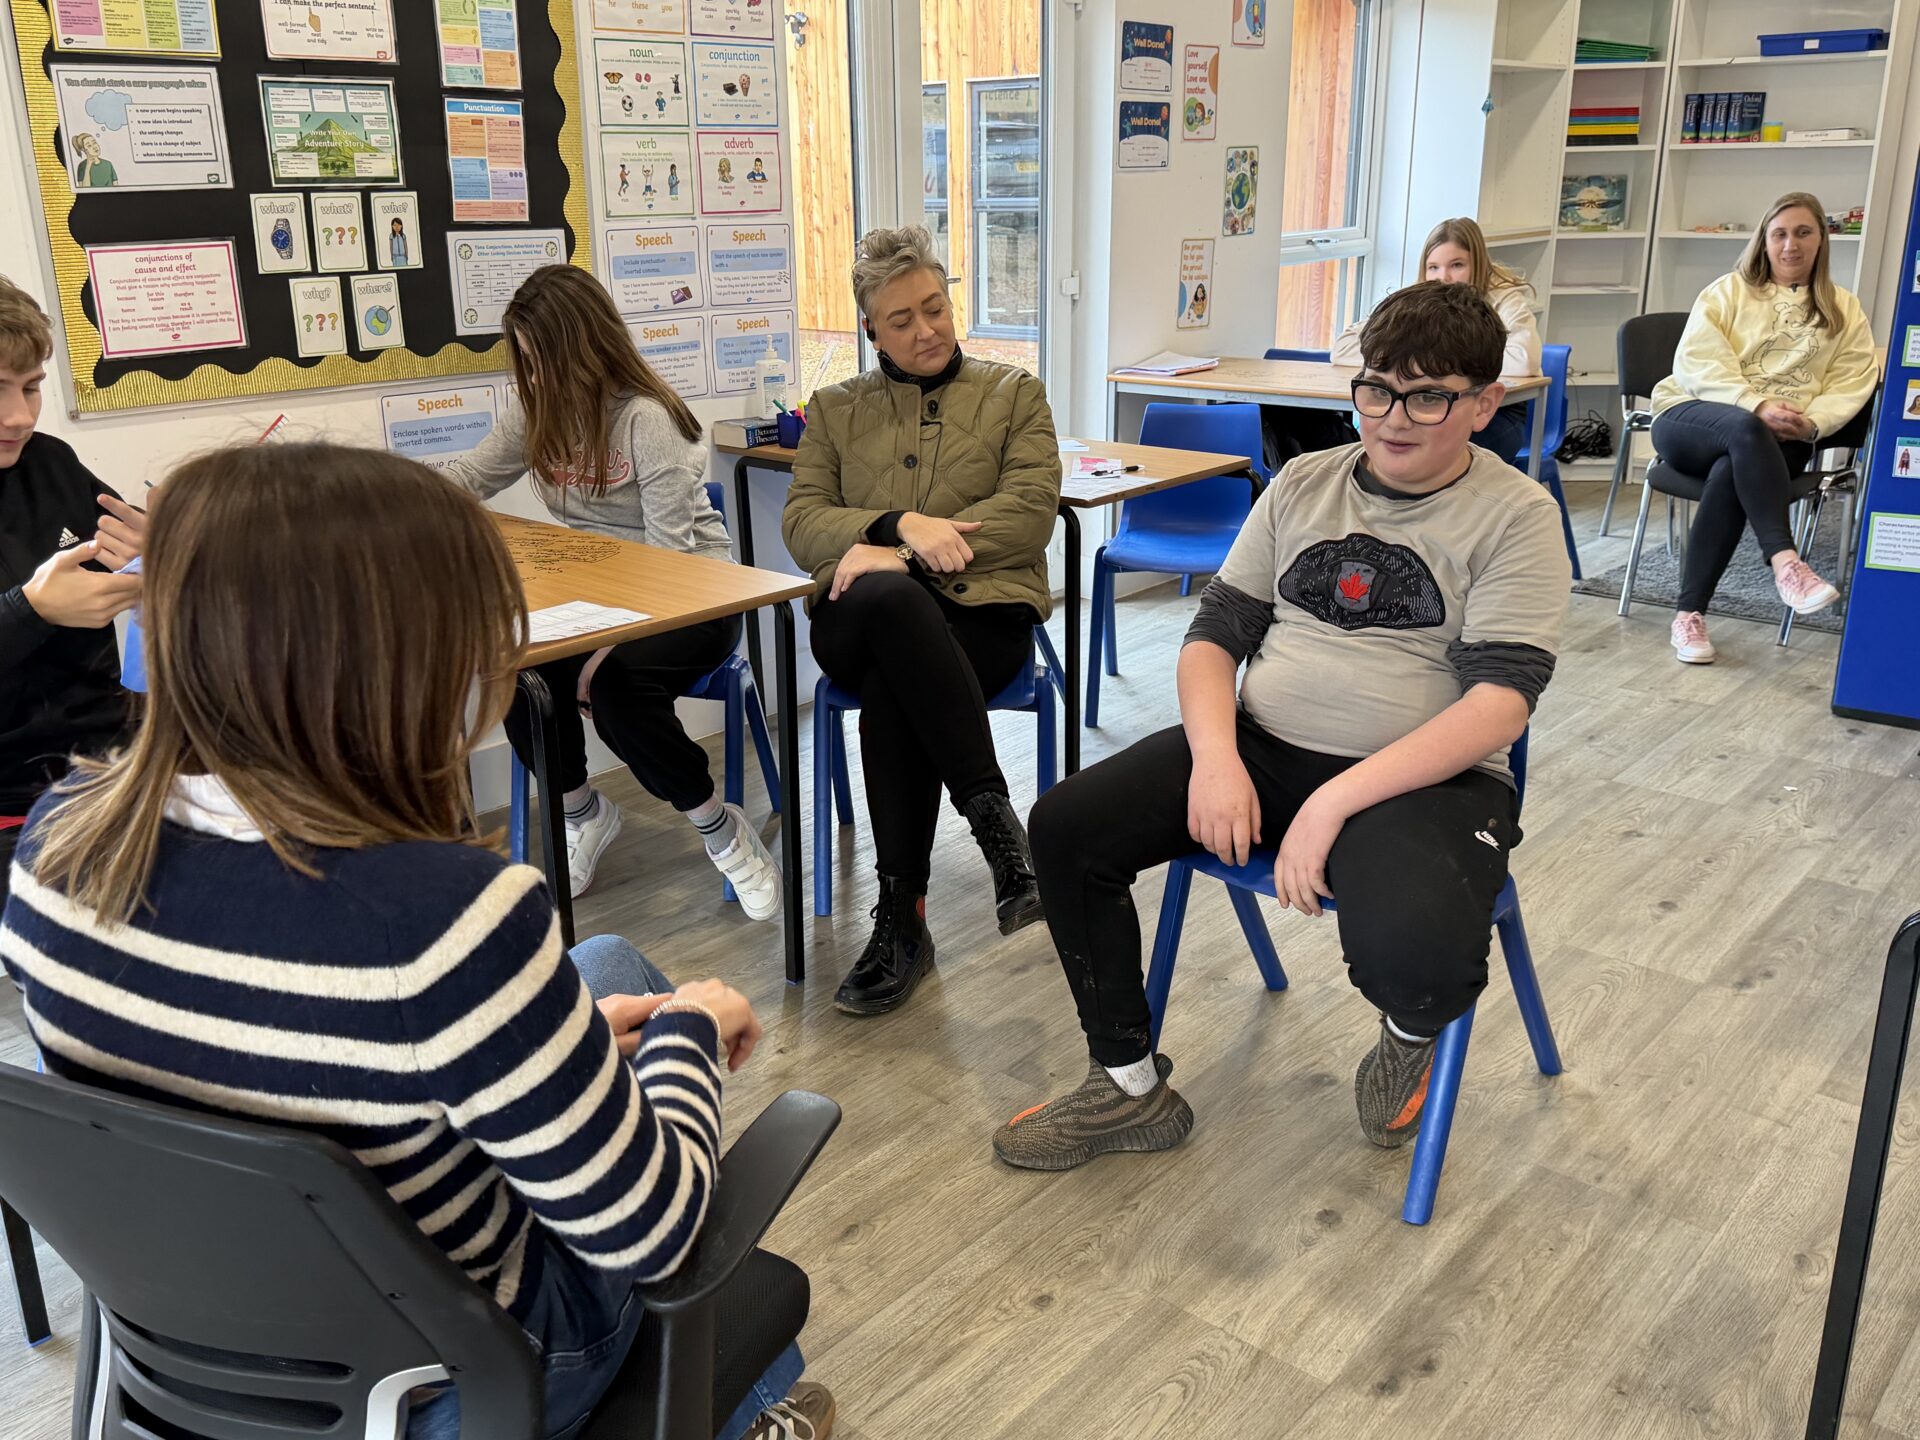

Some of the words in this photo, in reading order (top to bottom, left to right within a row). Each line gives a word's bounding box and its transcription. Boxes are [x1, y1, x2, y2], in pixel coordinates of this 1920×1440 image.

[324, 1, 346, 10] perfect
[632, 0, 648, 10] these
[661, 4, 672, 13] you
[1134, 37, 1147, 48] Well
[1147, 40, 1166, 49] Done!
[629, 48, 654, 57] noun
[709, 49, 760, 63] conjunction
[64, 78, 80, 87] You
[81, 78, 106, 88] should
[107, 79, 125, 88] start
[132, 80, 148, 88] new
[148, 79, 185, 90] paragraph
[185, 79, 207, 88] when
[1186, 74, 1198, 83] Love
[464, 103, 505, 112] Punctuation
[1130, 117, 1143, 125] Well
[1144, 117, 1162, 126] Done!
[304, 140, 342, 148] Adventure
[345, 140, 364, 148] Story
[636, 137, 656, 149] verb
[724, 137, 753, 149] adverb
[260, 202, 296, 214] when?
[320, 203, 354, 215] what?
[381, 202, 408, 214] who?
[635, 232, 673, 250] Speech
[732, 229, 766, 245] Speech
[135, 254, 183, 264] conjunctions
[185, 252, 193, 261] of
[747, 252, 750, 260] of
[135, 266, 156, 274] cause
[158, 264, 174, 272] and
[175, 264, 197, 273] effect
[302, 287, 332, 301] why?
[357, 282, 393, 295] where?
[736, 316, 770, 332] Speech
[642, 324, 679, 342] Speech
[417, 394, 463, 415] Speech
[393, 430, 418, 438] Enclose
[420, 426, 443, 436] spoken
[444, 424, 465, 432] words
[466, 421, 487, 430] within
[395, 438, 422, 448] inverted
[424, 436, 453, 445] commas.
[58, 535, 80, 548] adidas
